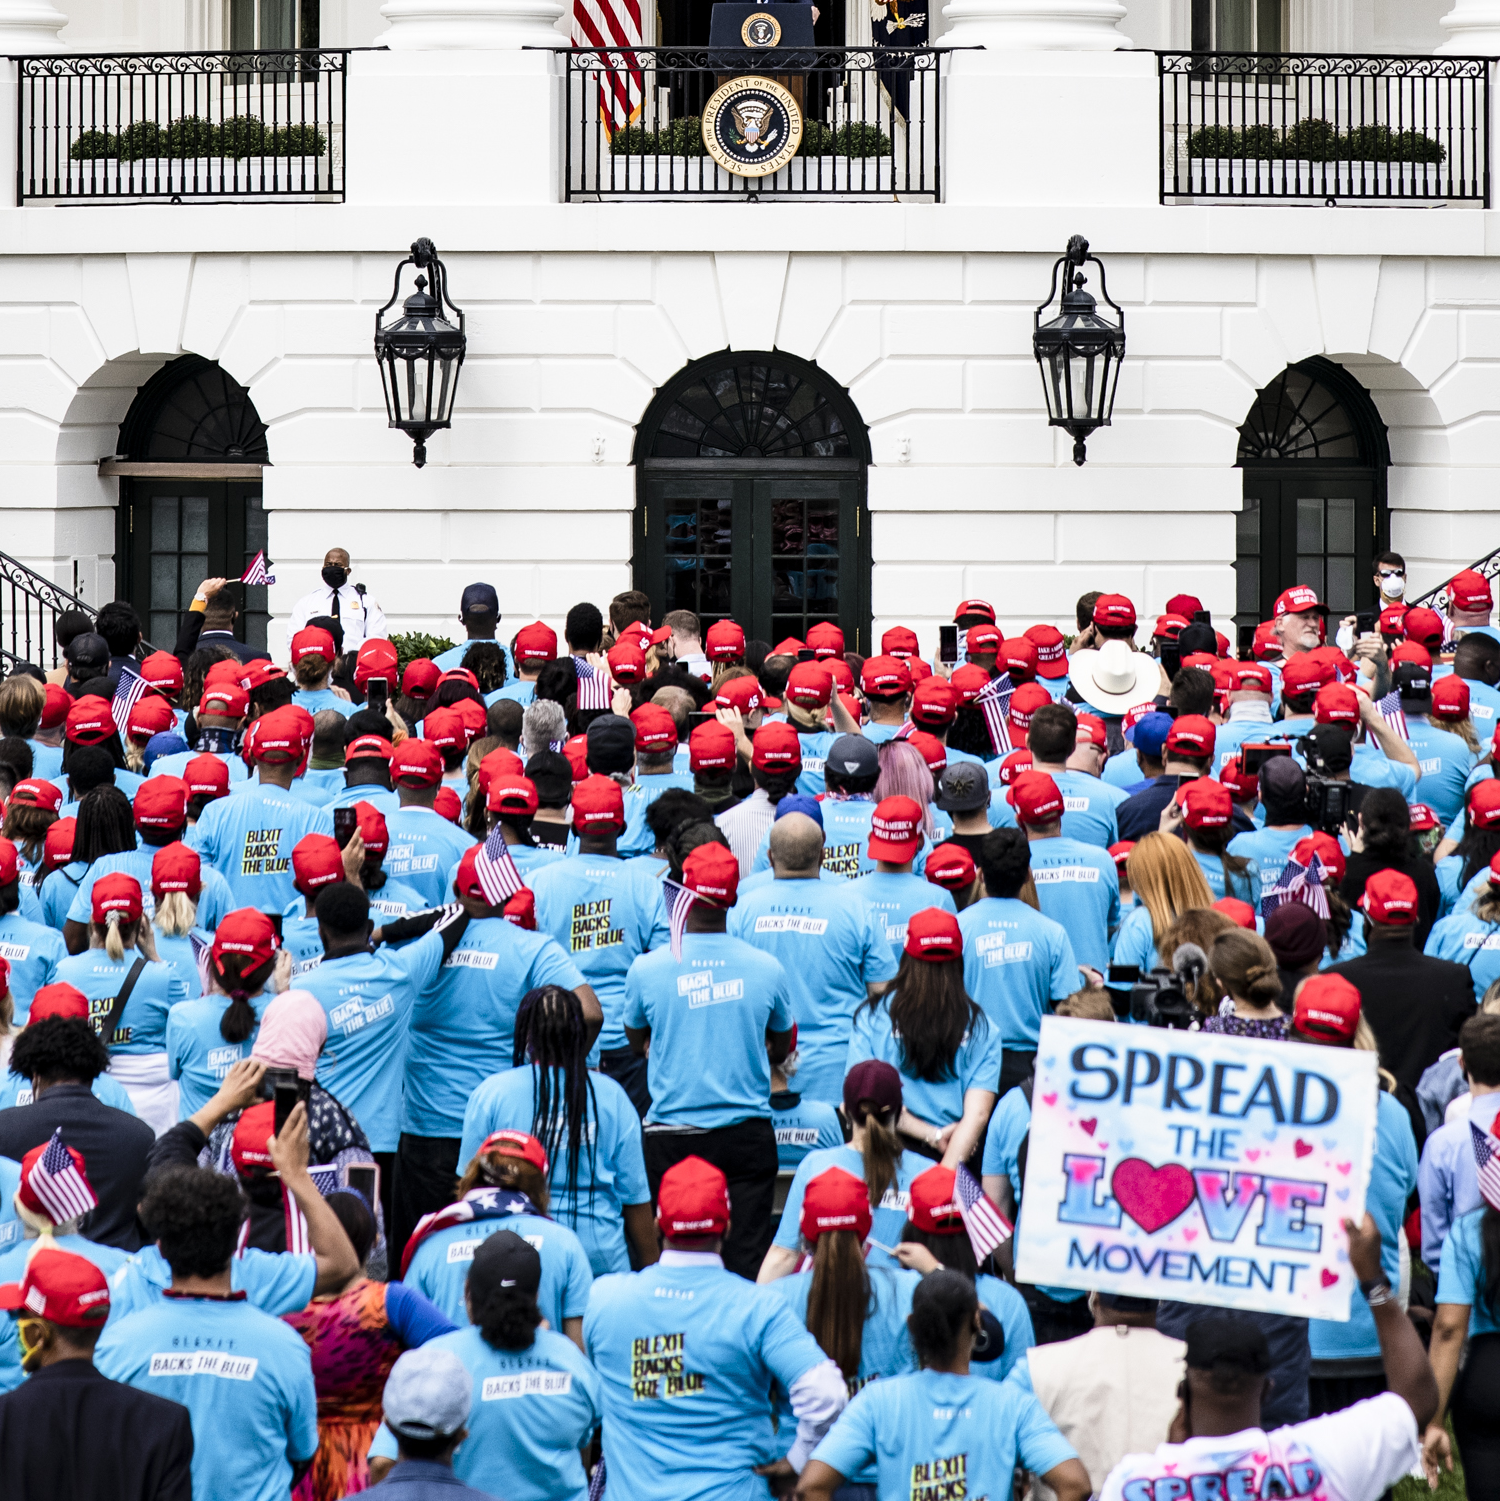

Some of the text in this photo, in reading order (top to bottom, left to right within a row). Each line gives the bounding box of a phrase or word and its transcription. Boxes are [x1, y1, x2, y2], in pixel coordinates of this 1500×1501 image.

[765, 82, 778, 92] THE
[705, 79, 750, 124] PRESIDENT
[780, 92, 800, 135] UNITED
[718, 152, 742, 172] SEAL
[760, 143, 795, 172] STATES
[747, 695, 759, 708] 45
[885, 820, 912, 830] AMERICA
[246, 828, 283, 845] BLEXIT
[890, 831, 909, 840] AGAIN
[244, 844, 279, 859] BACKS
[388, 847, 410, 860] BACK
[824, 843, 861, 860] BLEXIT
[241, 858, 290, 875] THE BLUE
[393, 855, 436, 873] THE BLUE
[1035, 867, 1097, 883] BACKS THE BLUE
[574, 900, 612, 919] BLEXIT
[572, 915, 611, 936] BACKS
[758, 917, 824, 932] BACKS THE BLUE
[571, 929, 625, 952] THE BLUE
[980, 936, 1004, 953] BACK
[6, 946, 28, 960] BLUE
[456, 953, 494, 968] THE BLUE
[987, 945, 1029, 963] THE BLUE
[680, 974, 709, 991] BACK
[689, 982, 742, 1004] THE BLUE
[333, 1003, 362, 1024] BACK
[345, 1000, 392, 1031] THE BLUE
[210, 1049, 239, 1065] BACK
[1069, 1043, 1341, 1126] SPREAD
[1167, 1124, 1241, 1161] THE
[1067, 1239, 1310, 1294] MOVEMENT
[634, 1334, 685, 1355] BLEXIT
[153, 1354, 252, 1377] BACKS THE BLUE
[634, 1356, 684, 1375] BACKS
[487, 1375, 570, 1396] BACKS THE BLUE
[666, 1373, 706, 1397] BLUE
[915, 1455, 968, 1482] BLEXIT
